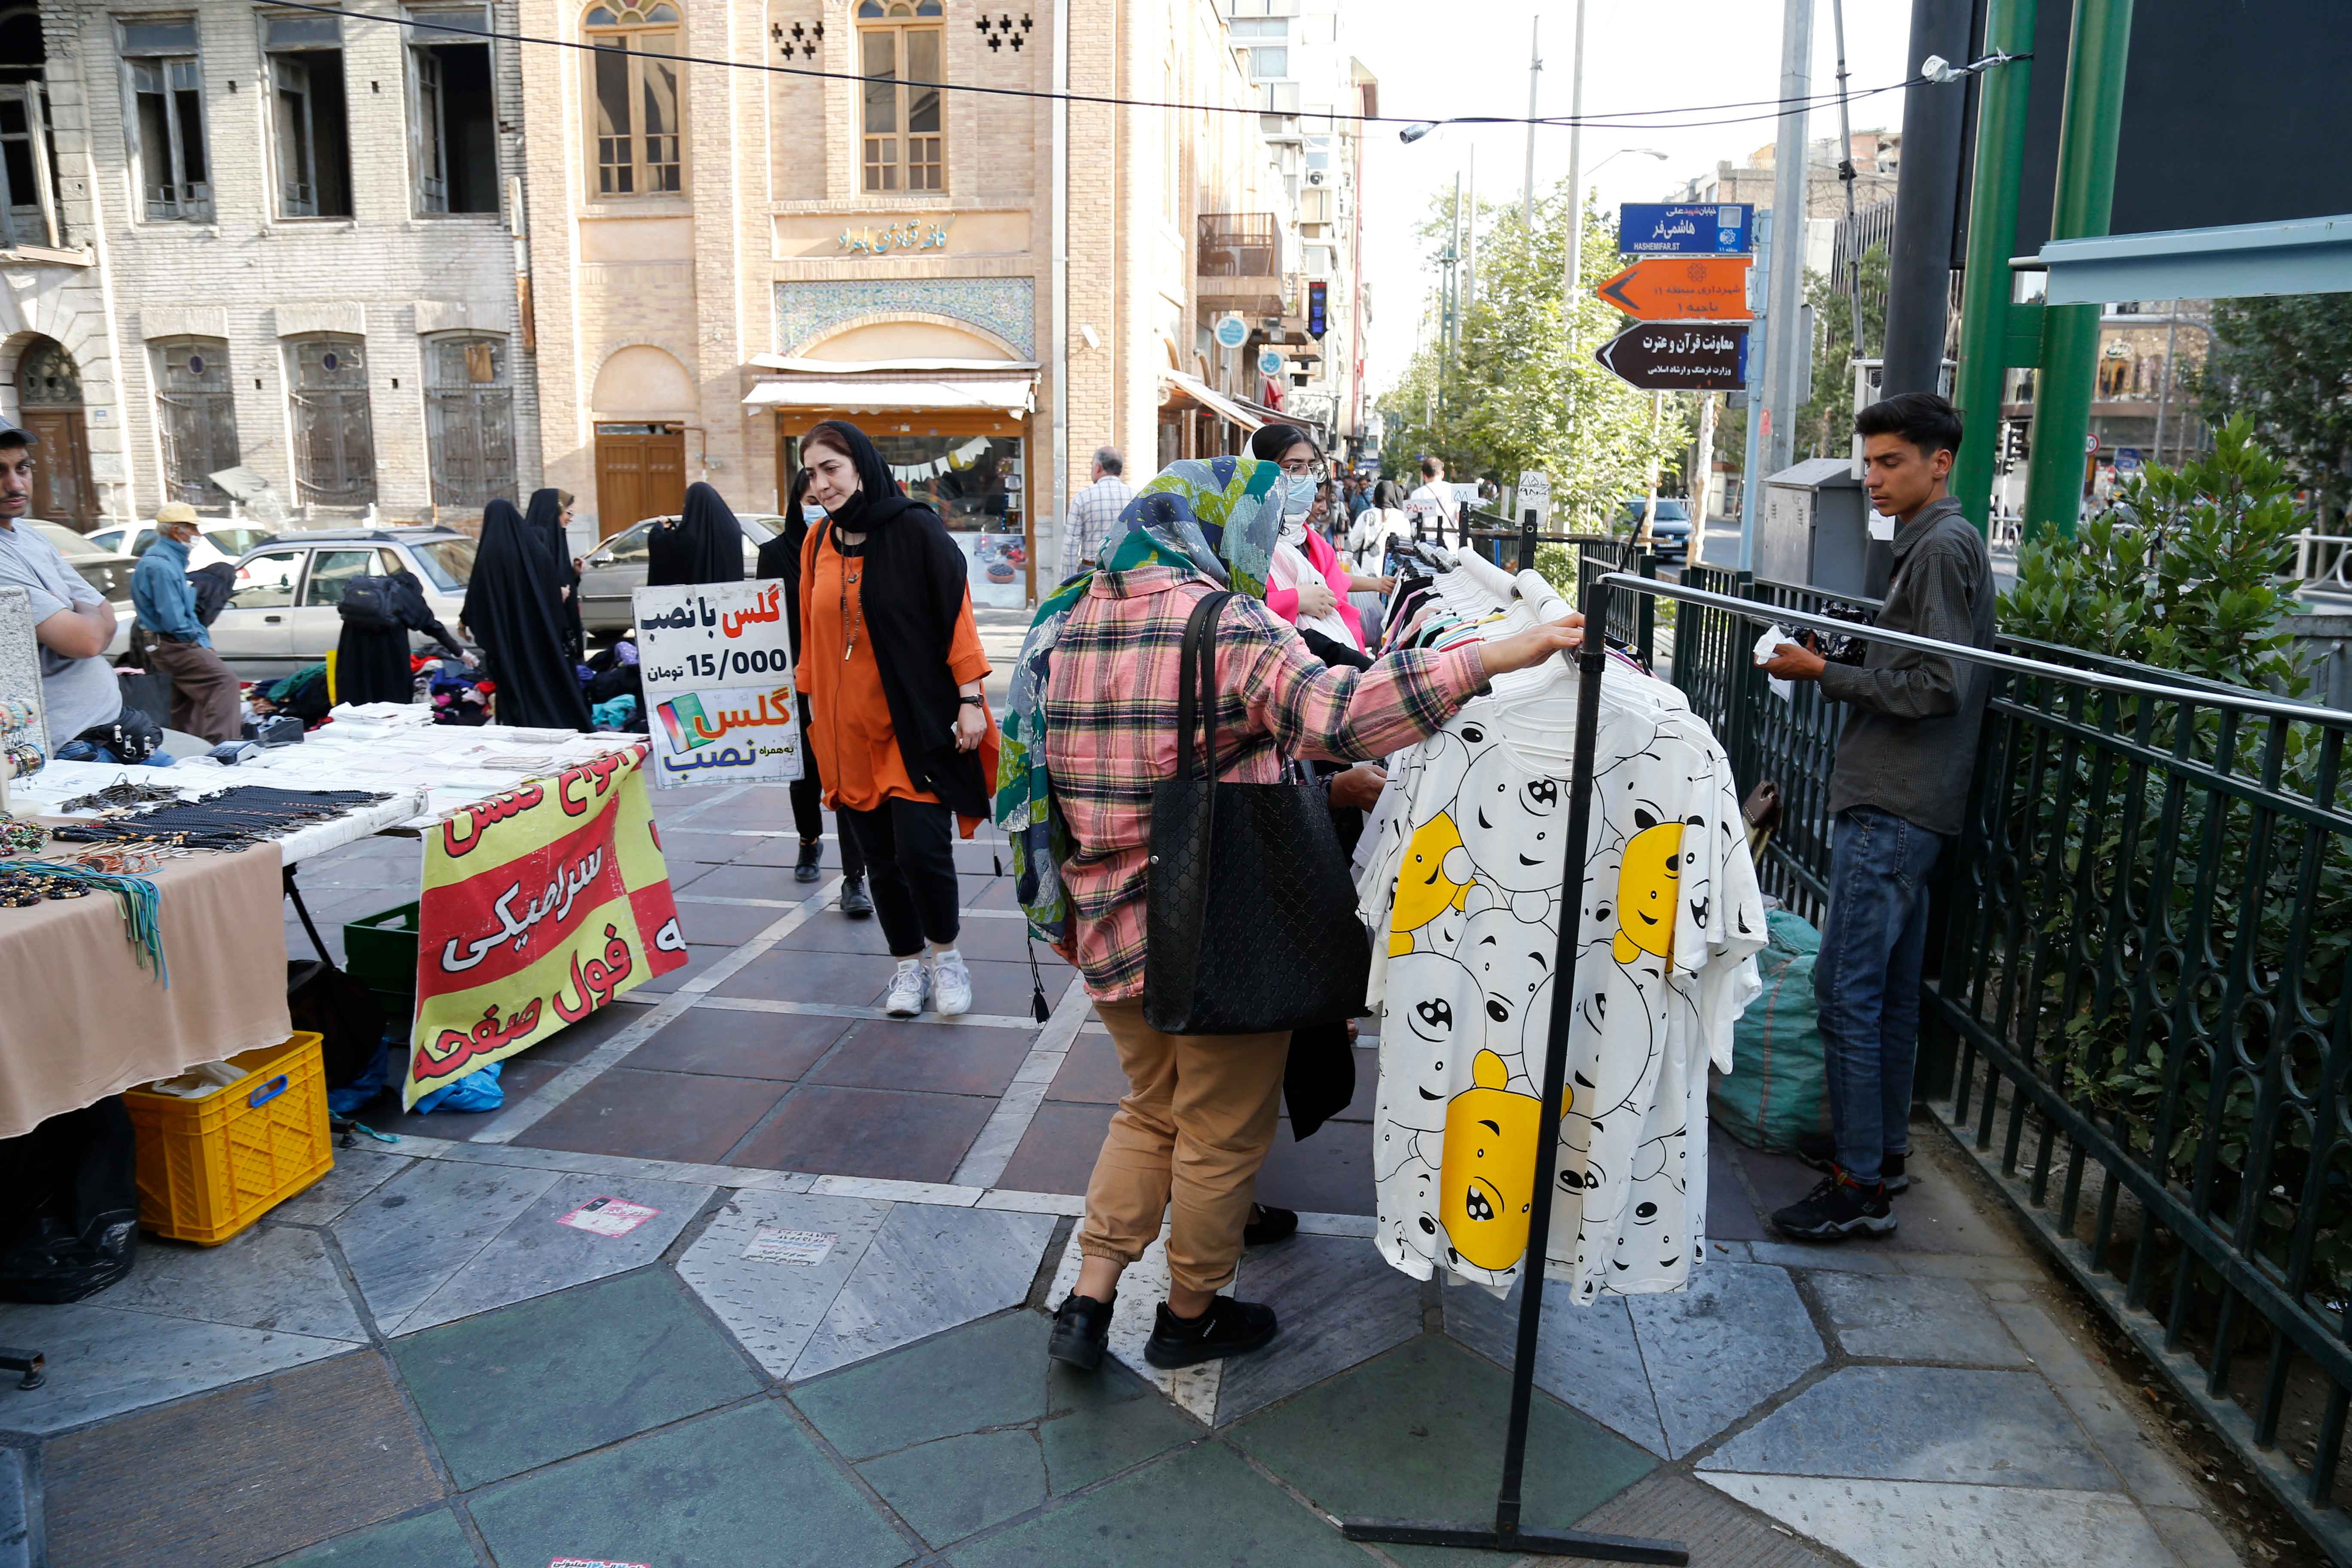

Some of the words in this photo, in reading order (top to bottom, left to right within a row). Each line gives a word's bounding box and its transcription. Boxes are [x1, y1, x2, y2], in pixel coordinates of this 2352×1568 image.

[1666, 207, 1684, 217] علی
[1684, 207, 1700, 216] شهید
[1699, 206, 1717, 216] خیابان
[1634, 242, 1680, 251] HASHEMIFAR.ST
[1654, 287, 1663, 295] ۱۱
[1698, 283, 1740, 295] شهرداری
[1678, 303, 1683, 312] ۱
[1687, 302, 1719, 312] ناحیه
[1643, 336, 1667, 353] عترت
[1668, 340, 1675, 353] و
[1676, 333, 1700, 354] قرآن
[1702, 334, 1734, 355] معاونت
[1648, 365, 1669, 375] اسلامی
[1669, 365, 1686, 375] ارشاد
[1691, 365, 1712, 375] فرهنگ
[1712, 366, 1731, 376] وزارت
[698, 596, 717, 639] با
[723, 583, 780, 639] گلس
[640, 597, 695, 642] نصب
[686, 649, 787, 681] 15/000
[647, 665, 683, 682] تومان
[694, 686, 791, 739] گلس
[664, 738, 756, 781] نصب
[441, 844, 603, 974] سرامیکی
[554, 922, 633, 1025] فول
[413, 997, 542, 1084] صفحه
